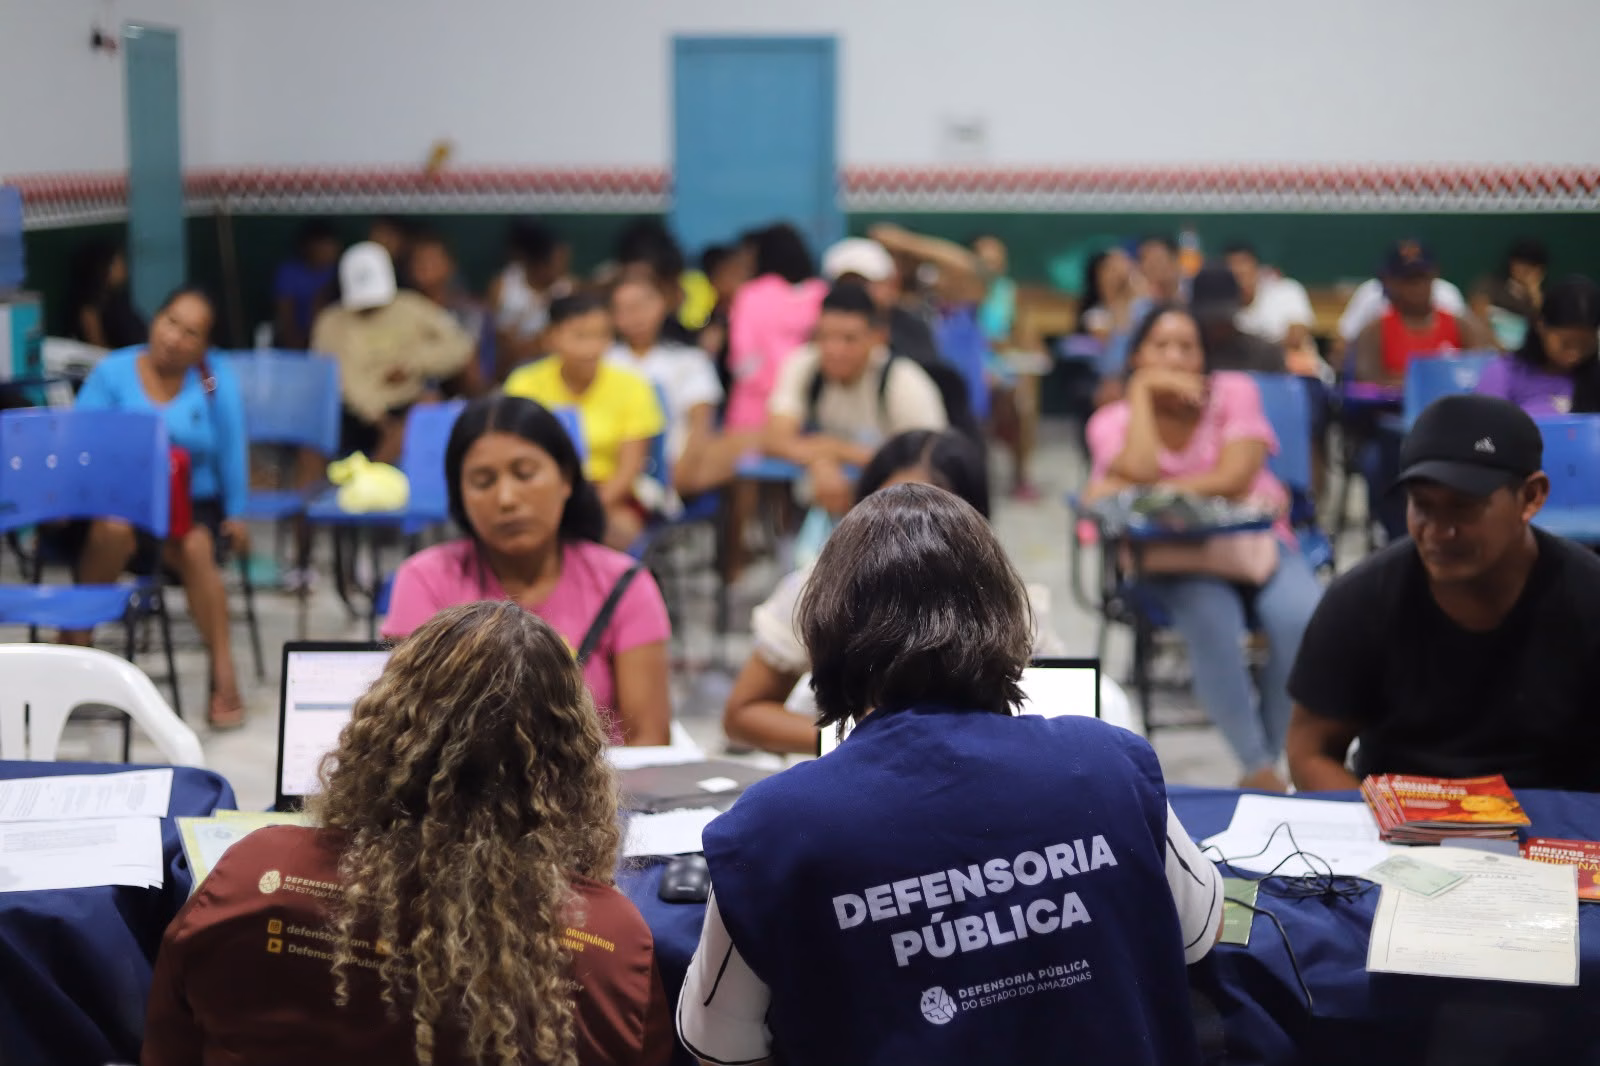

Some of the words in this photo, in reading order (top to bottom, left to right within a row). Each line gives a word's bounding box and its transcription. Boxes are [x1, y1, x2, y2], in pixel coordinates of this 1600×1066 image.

[282, 883, 295, 891] DO
[295, 886, 327, 898] ESTADO
[285, 875, 344, 892] DEFENSORIA
[832, 834, 1118, 930] DEFENSORIA
[566, 928, 615, 952] ORIGINÁRIOS
[890, 891, 1092, 967] PÚBLICA
[958, 972, 1035, 998] DEFENSORIA
[1038, 959, 1089, 979] PÚBLICA
[961, 999, 978, 1011] DO
[980, 989, 1017, 1007] ESTADO
[1019, 985, 1035, 996] DO
[1037, 971, 1092, 991] AMAZONAS
